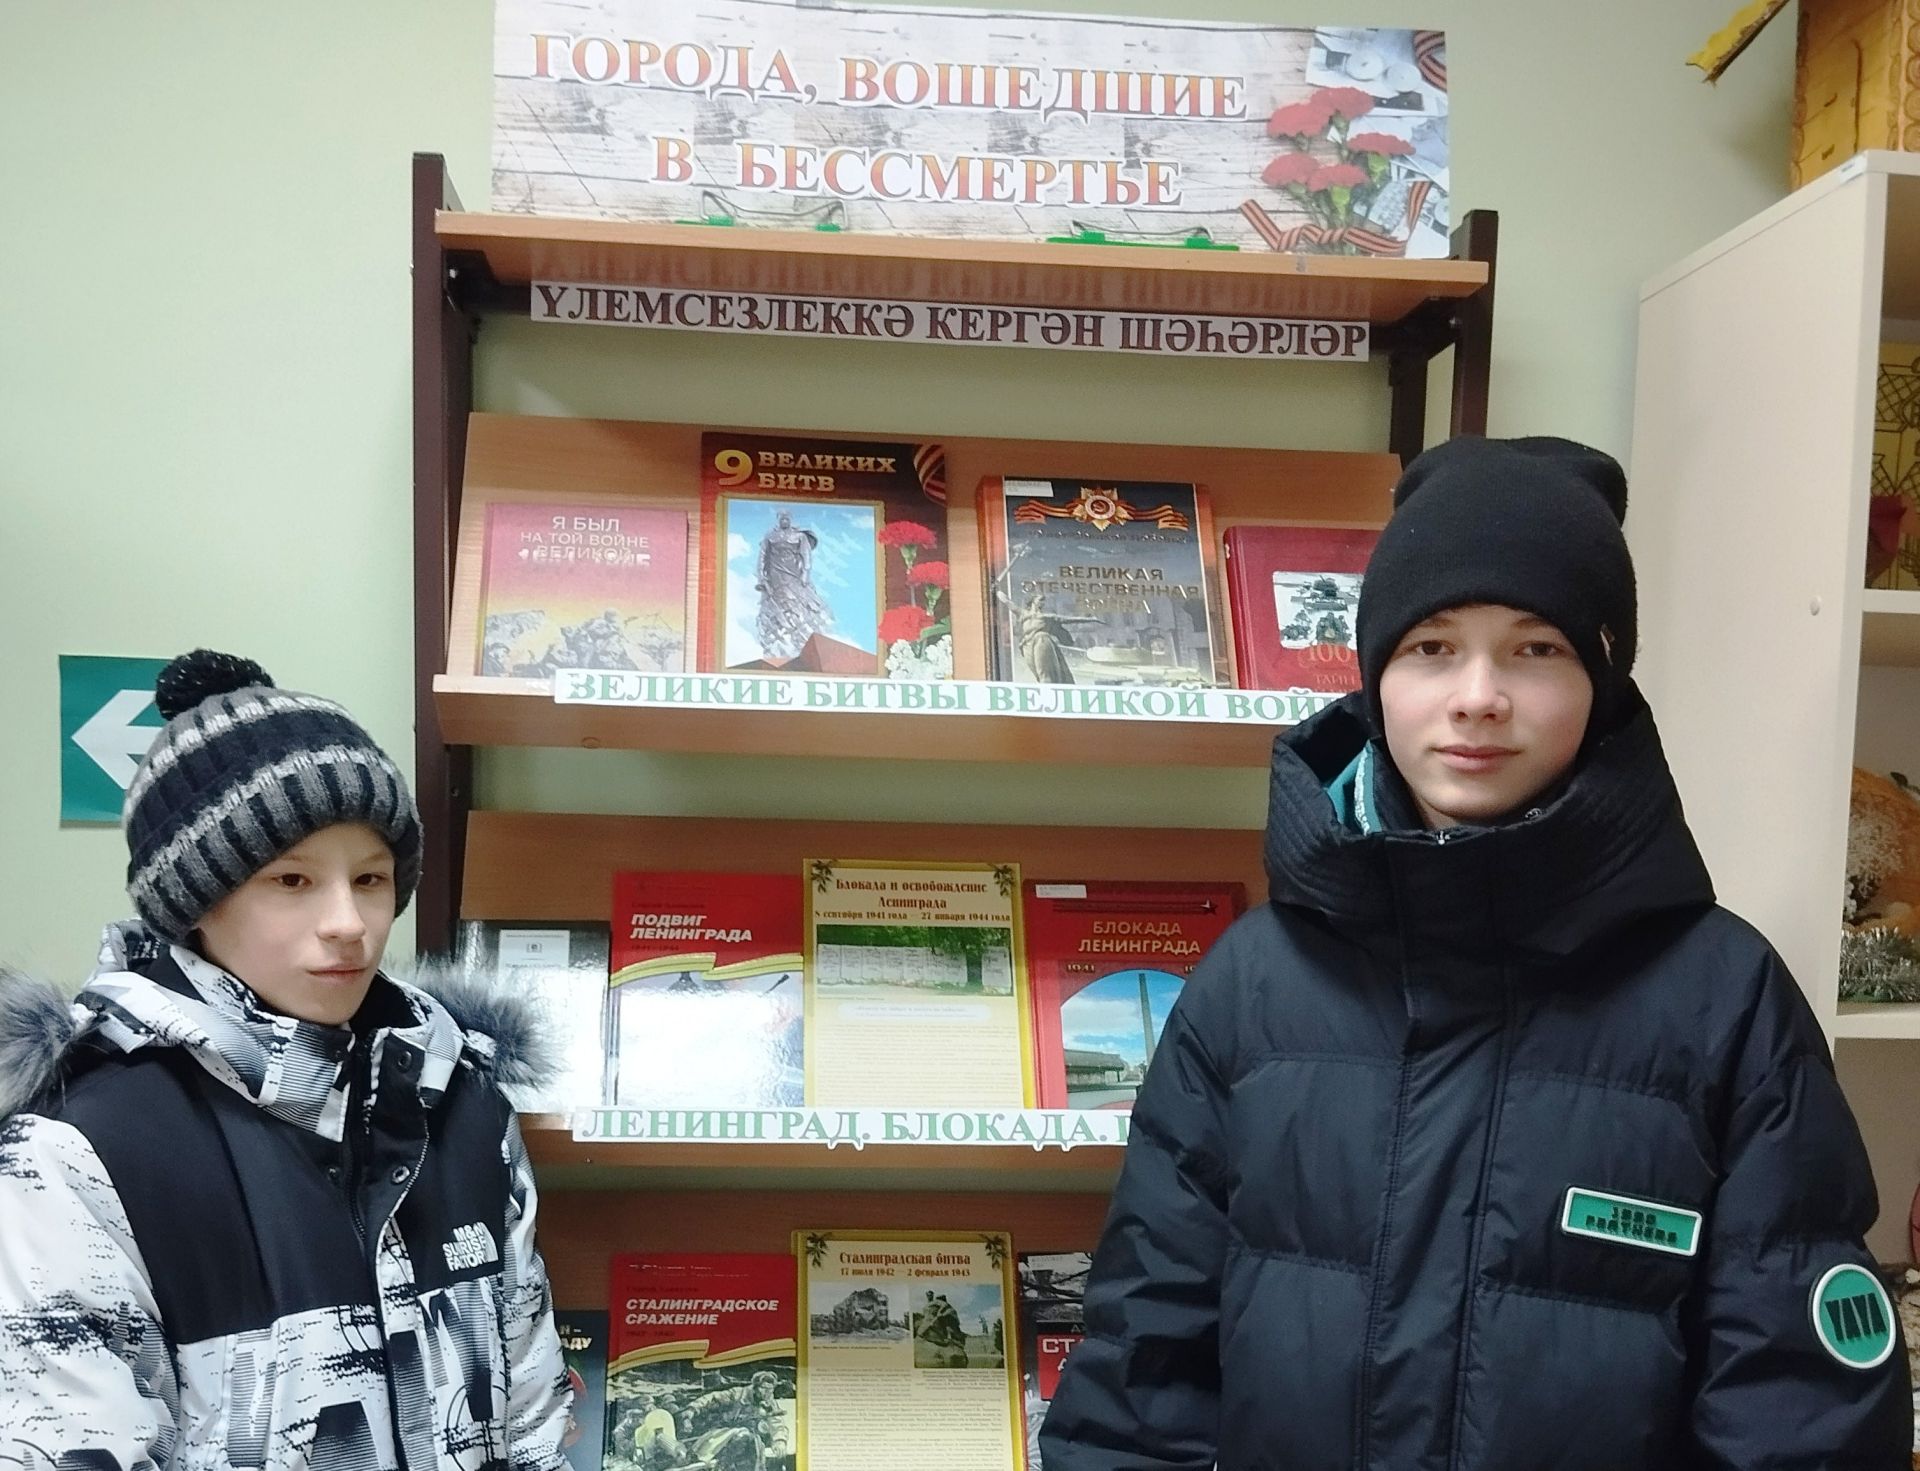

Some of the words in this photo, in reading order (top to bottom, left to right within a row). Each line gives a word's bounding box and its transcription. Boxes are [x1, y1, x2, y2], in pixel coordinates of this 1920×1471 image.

[531, 34, 817, 98] ГОРОДА,
[839, 57, 1247, 122] ВОШЕДШИЕ
[653, 137, 693, 183] В
[736, 142, 1181, 206] БЕССМЕРТЬЕ
[926, 306, 1104, 348] КЕРГӘН
[714, 449, 753, 486] 9
[758, 451, 897, 473] ВЕЛИКИХ
[758, 472, 835, 492] БИТВ
[552, 516, 566, 529] Я
[573, 517, 620, 532] БЫЛ
[520, 532, 542, 543] НА
[548, 532, 583, 545] ТОЙ
[589, 533, 649, 548] ВОЙНЕ
[1059, 566, 1163, 581] ВЕЛИКАЯ
[1022, 580, 1199, 599] ОТЕЧЕСТВЕННАЯ
[1309, 643, 1350, 663] 100
[566, 673, 793, 704] ВЕЛИКИЕ
[803, 680, 970, 711] БИТВЫ
[987, 684, 1207, 718] ВЕЛИКОЙ
[1224, 689, 1334, 721] ВОЙ
[836, 879, 886, 891] Блокада
[891, 880, 897, 891] и
[902, 880, 987, 893] освобождение
[878, 897, 947, 909] Ленинграда
[631, 914, 707, 928] ПОДВИГ
[1093, 921, 1182, 936] БЛОКАДА
[630, 928, 752, 942] ЛЕНИНГРАДА
[1078, 939, 1201, 955] ЛЕНИНГРАДА
[582, 1110, 870, 1145] ЛЕНИНГРАД.
[881, 1112, 1107, 1145] БЛОКАДА.
[840, 1252, 932, 1265] Сталинградская
[936, 1252, 971, 1265] битва
[626, 1299, 779, 1312] СТАЛИНГРАДСКОЕ
[625, 1313, 719, 1325] СРАЖЕНИЕ
[1043, 1339, 1084, 1353] СТ
